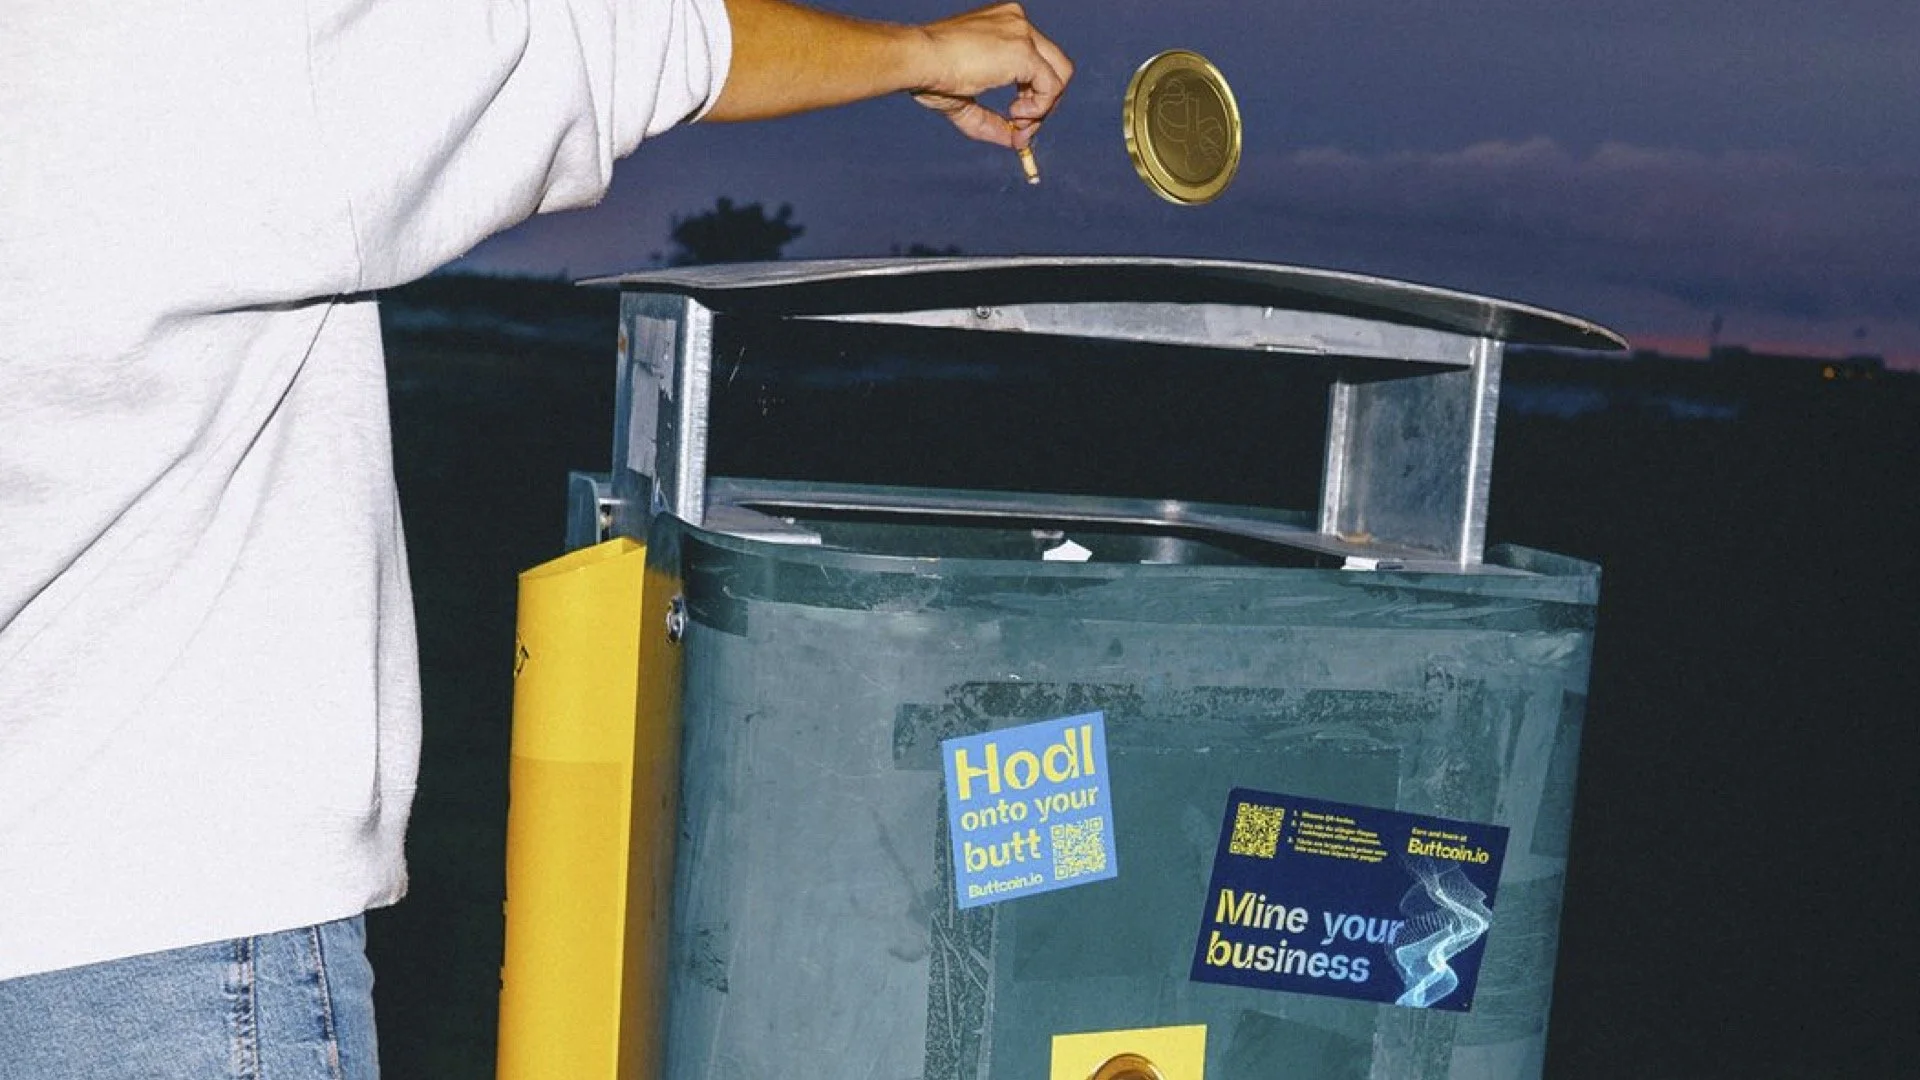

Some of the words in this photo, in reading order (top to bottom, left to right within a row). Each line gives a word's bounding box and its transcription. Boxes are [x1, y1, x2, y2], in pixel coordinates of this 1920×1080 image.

[955, 724, 1096, 800] Hodl
[961, 799, 1029, 832] onto
[1034, 786, 1100, 824] your
[963, 828, 1042, 874] butt
[1407, 837, 1490, 865] Buttcoin.io
[968, 872, 1044, 899] Buttcoin.io
[1215, 888, 1309, 933] Mine
[1320, 911, 1404, 945] your
[1206, 930, 1371, 983] business
